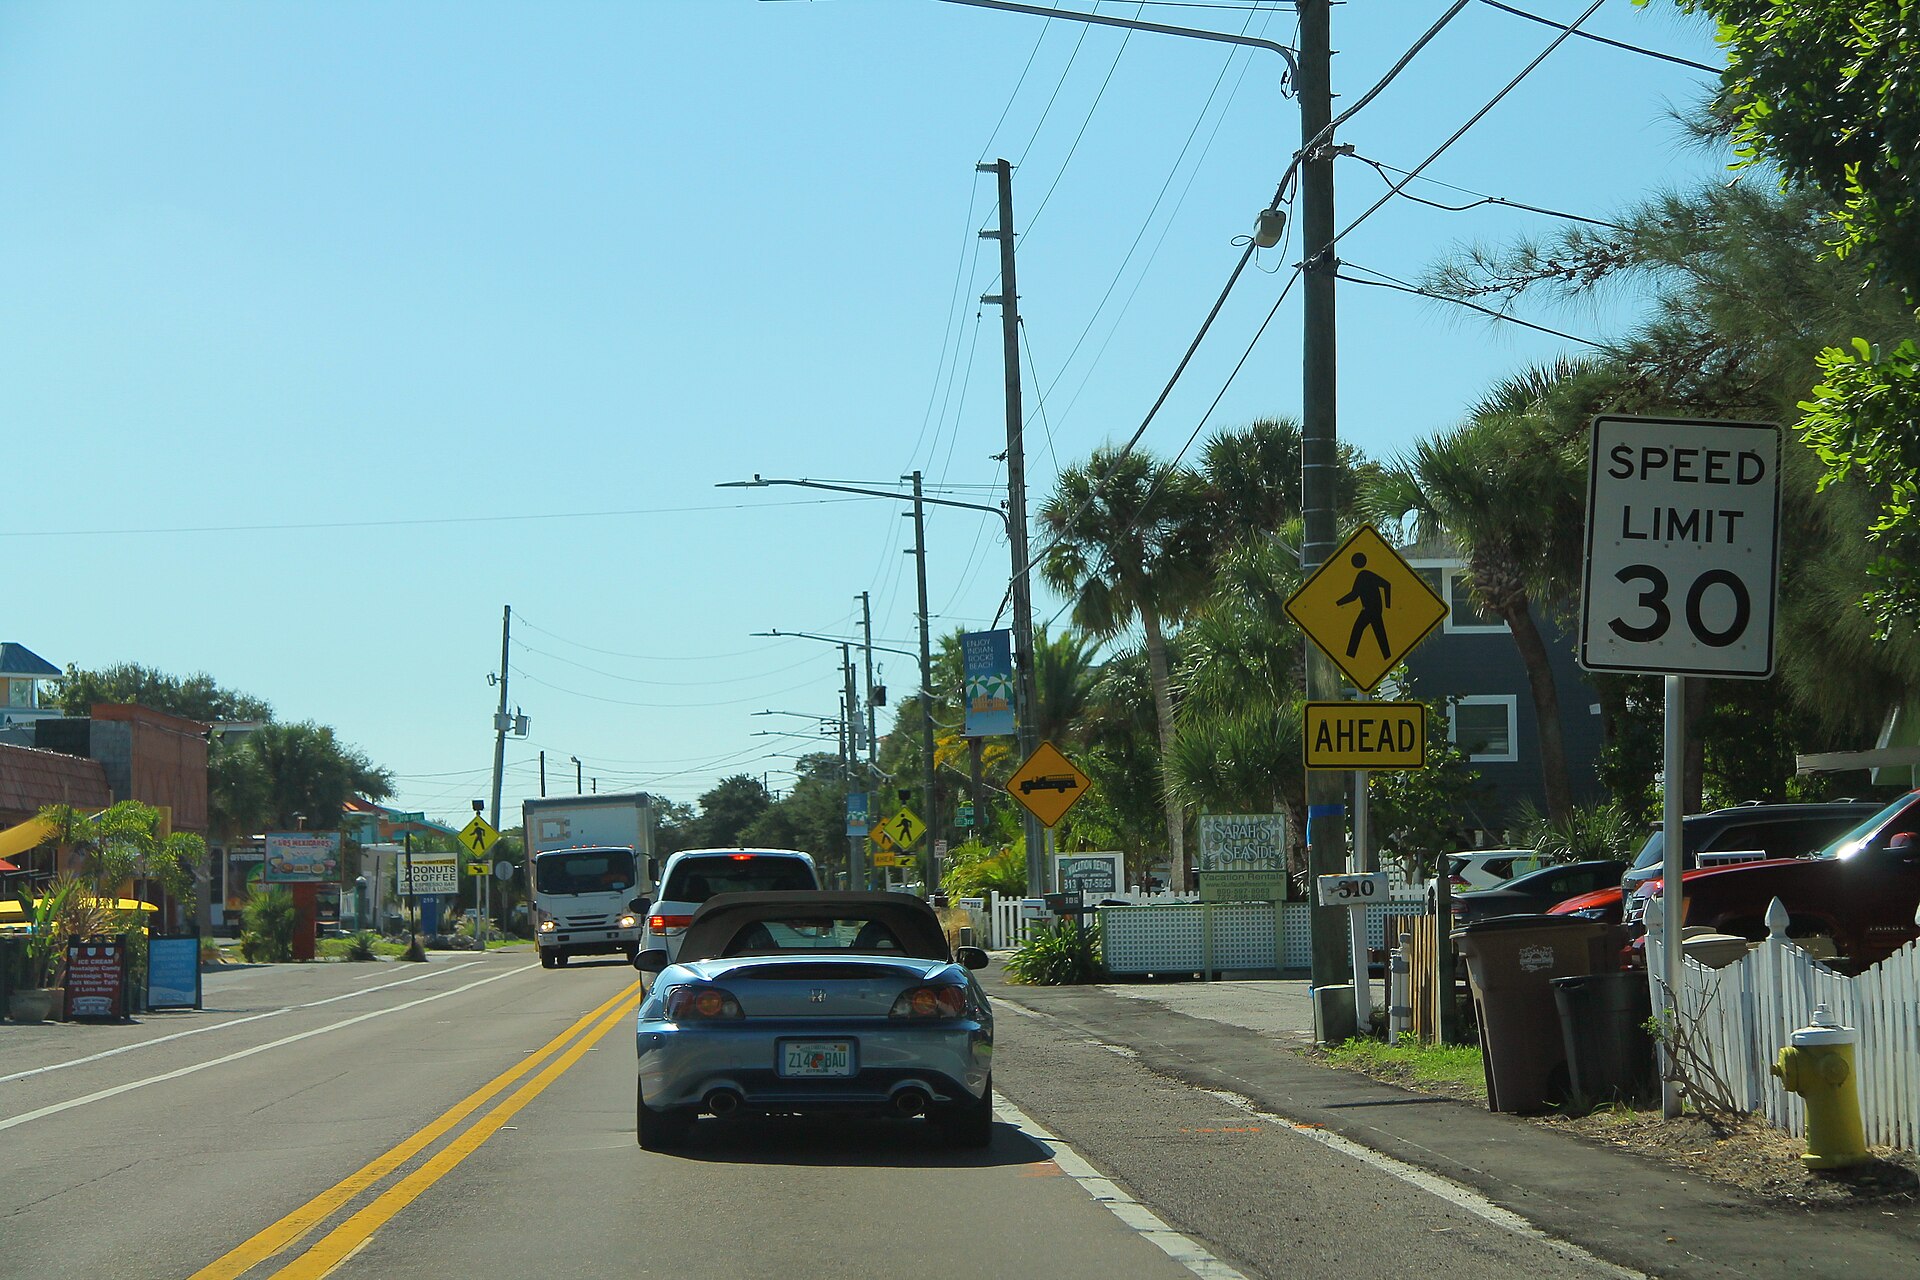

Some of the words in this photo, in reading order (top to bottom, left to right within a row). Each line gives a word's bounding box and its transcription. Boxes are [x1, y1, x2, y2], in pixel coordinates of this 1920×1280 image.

[1607, 445, 1766, 486] SPEED
[1622, 505, 1745, 544] LIMIT
[1607, 564, 1751, 648] 30
[966, 638, 990, 647] ENJOY
[967, 646, 993, 654] INDIAN
[968, 654, 993, 662] ROCKS
[969, 662, 993, 670] BEACH
[1314, 719, 1416, 753] AHEAD
[413, 865, 456, 874] DONUTS
[1067, 860, 1093, 876] VACATION
[1093, 859, 1113, 875] RENTAL
[413, 873, 456, 882] COFFEE
[1247, 873, 1284, 881] Rentals
[1064, 879, 1077, 889] 313
[1338, 879, 1375, 899] 310
[789, 1053, 810, 1068] Z14
[825, 1053, 846, 1068] BAU
